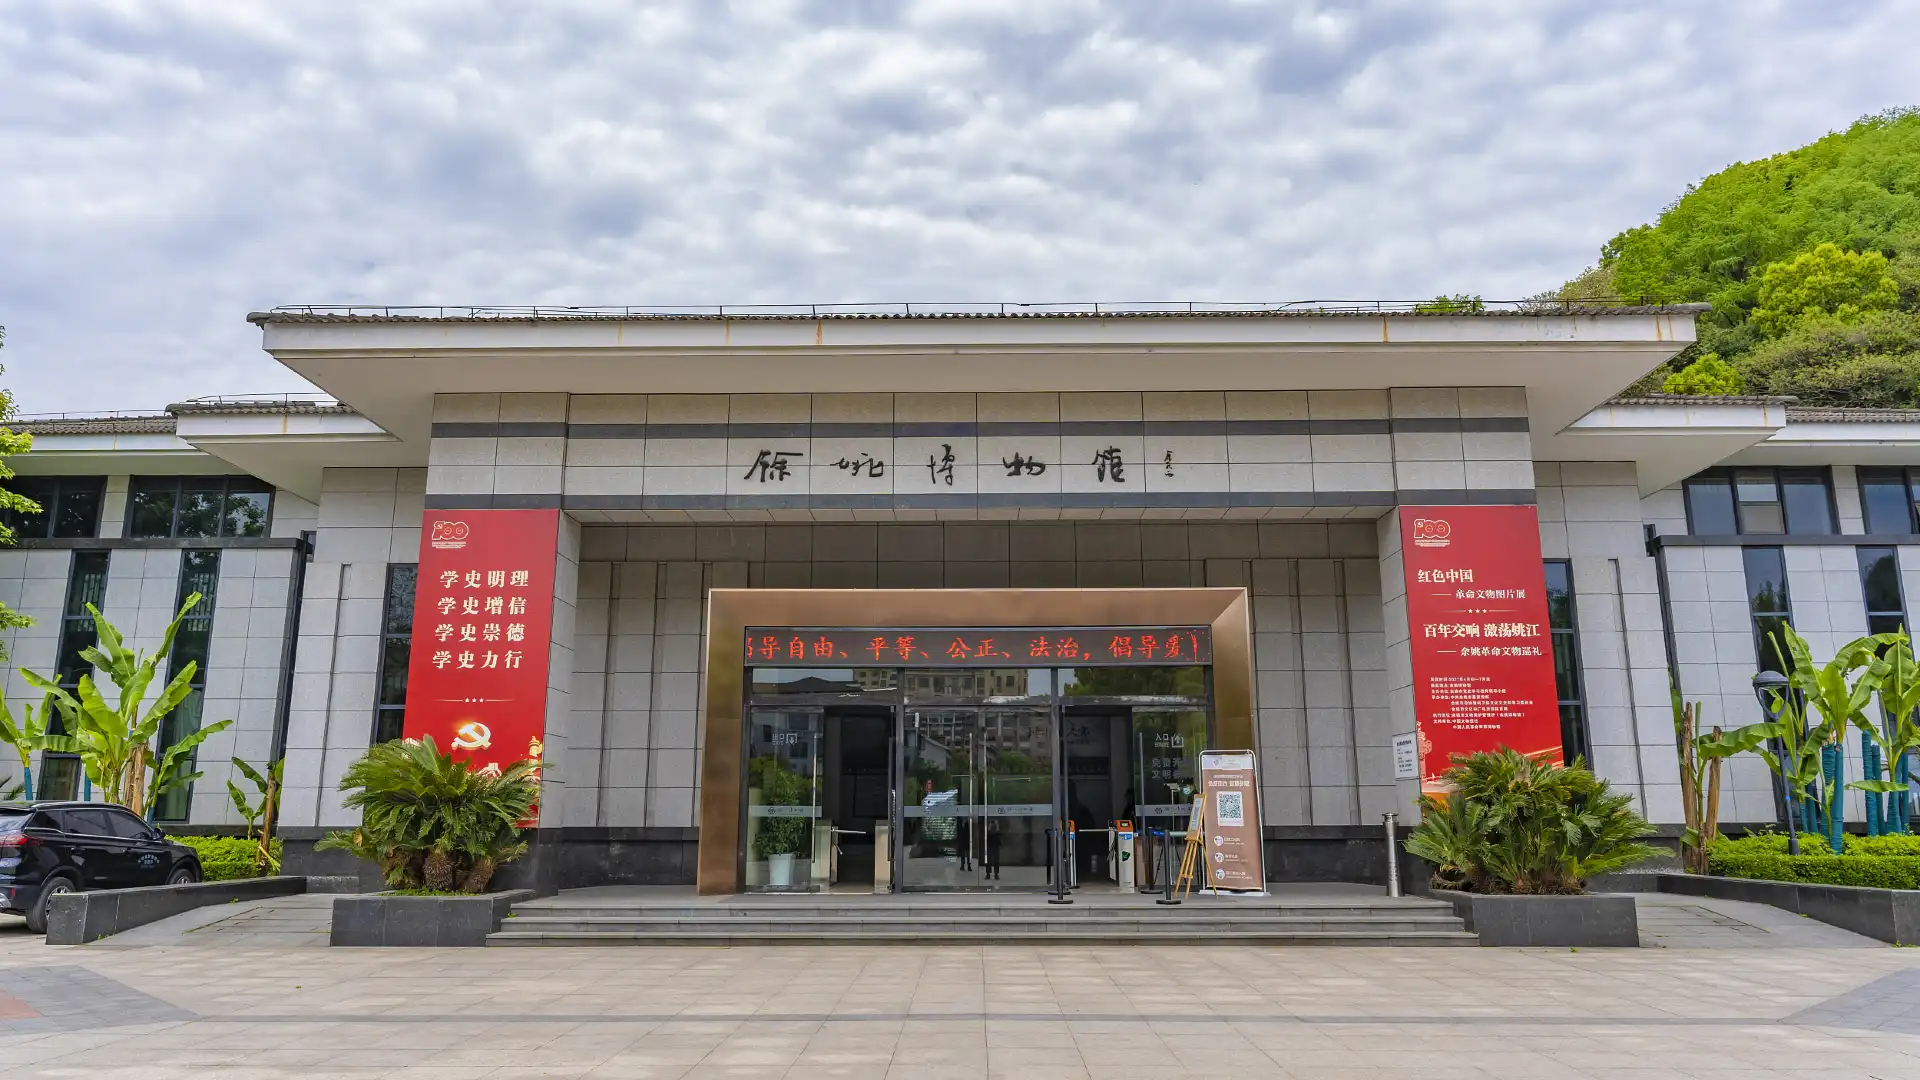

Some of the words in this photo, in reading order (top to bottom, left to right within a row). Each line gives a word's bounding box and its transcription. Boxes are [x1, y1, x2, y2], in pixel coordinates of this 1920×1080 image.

[439, 570, 529, 589] 学史明理
[1417, 568, 1474, 583] 红色中国
[437, 596, 527, 615] 学史增信
[434, 623, 525, 642] 学史崇德
[1423, 623, 1480, 638] 百年交响
[1483, 623, 1541, 638] 激荡姚江
[432, 650, 523, 669] 学史力行
[1155, 733, 1169, 741] 入口
